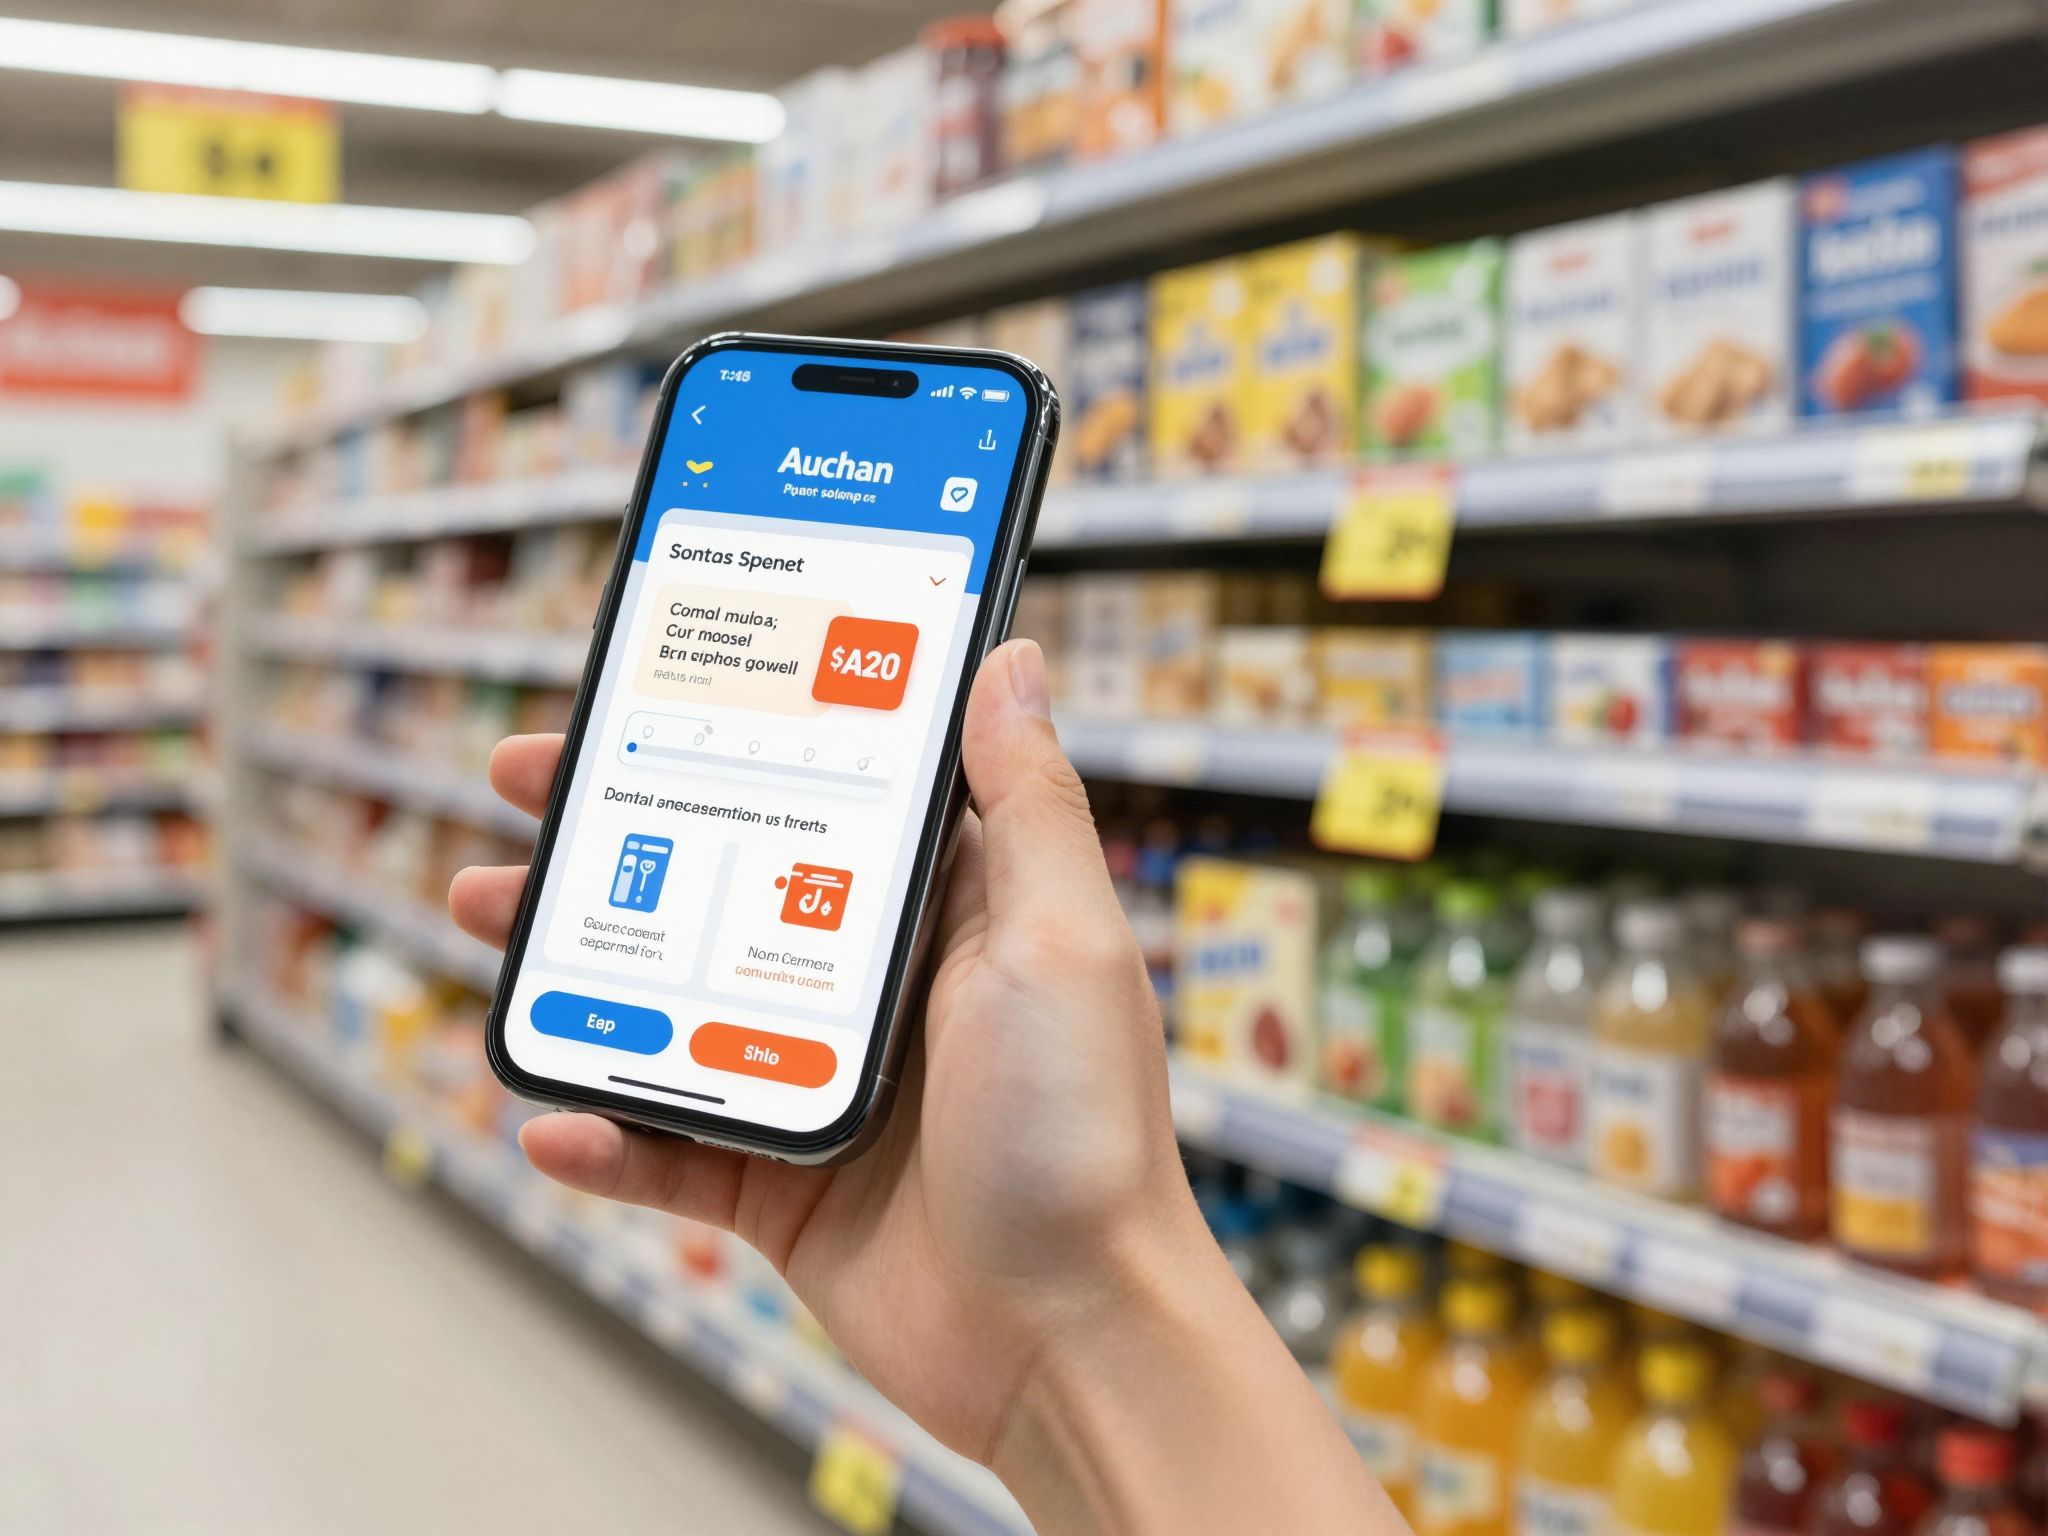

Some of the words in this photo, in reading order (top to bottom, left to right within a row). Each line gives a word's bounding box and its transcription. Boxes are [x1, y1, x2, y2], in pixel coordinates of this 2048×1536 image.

[776, 446, 895, 485] Auchan
[668, 542, 734, 566] Sontas
[737, 550, 805, 574] Spenet
[744, 657, 799, 676] gowell
[829, 645, 901, 682] $A20
[586, 1011, 617, 1036] Eap
